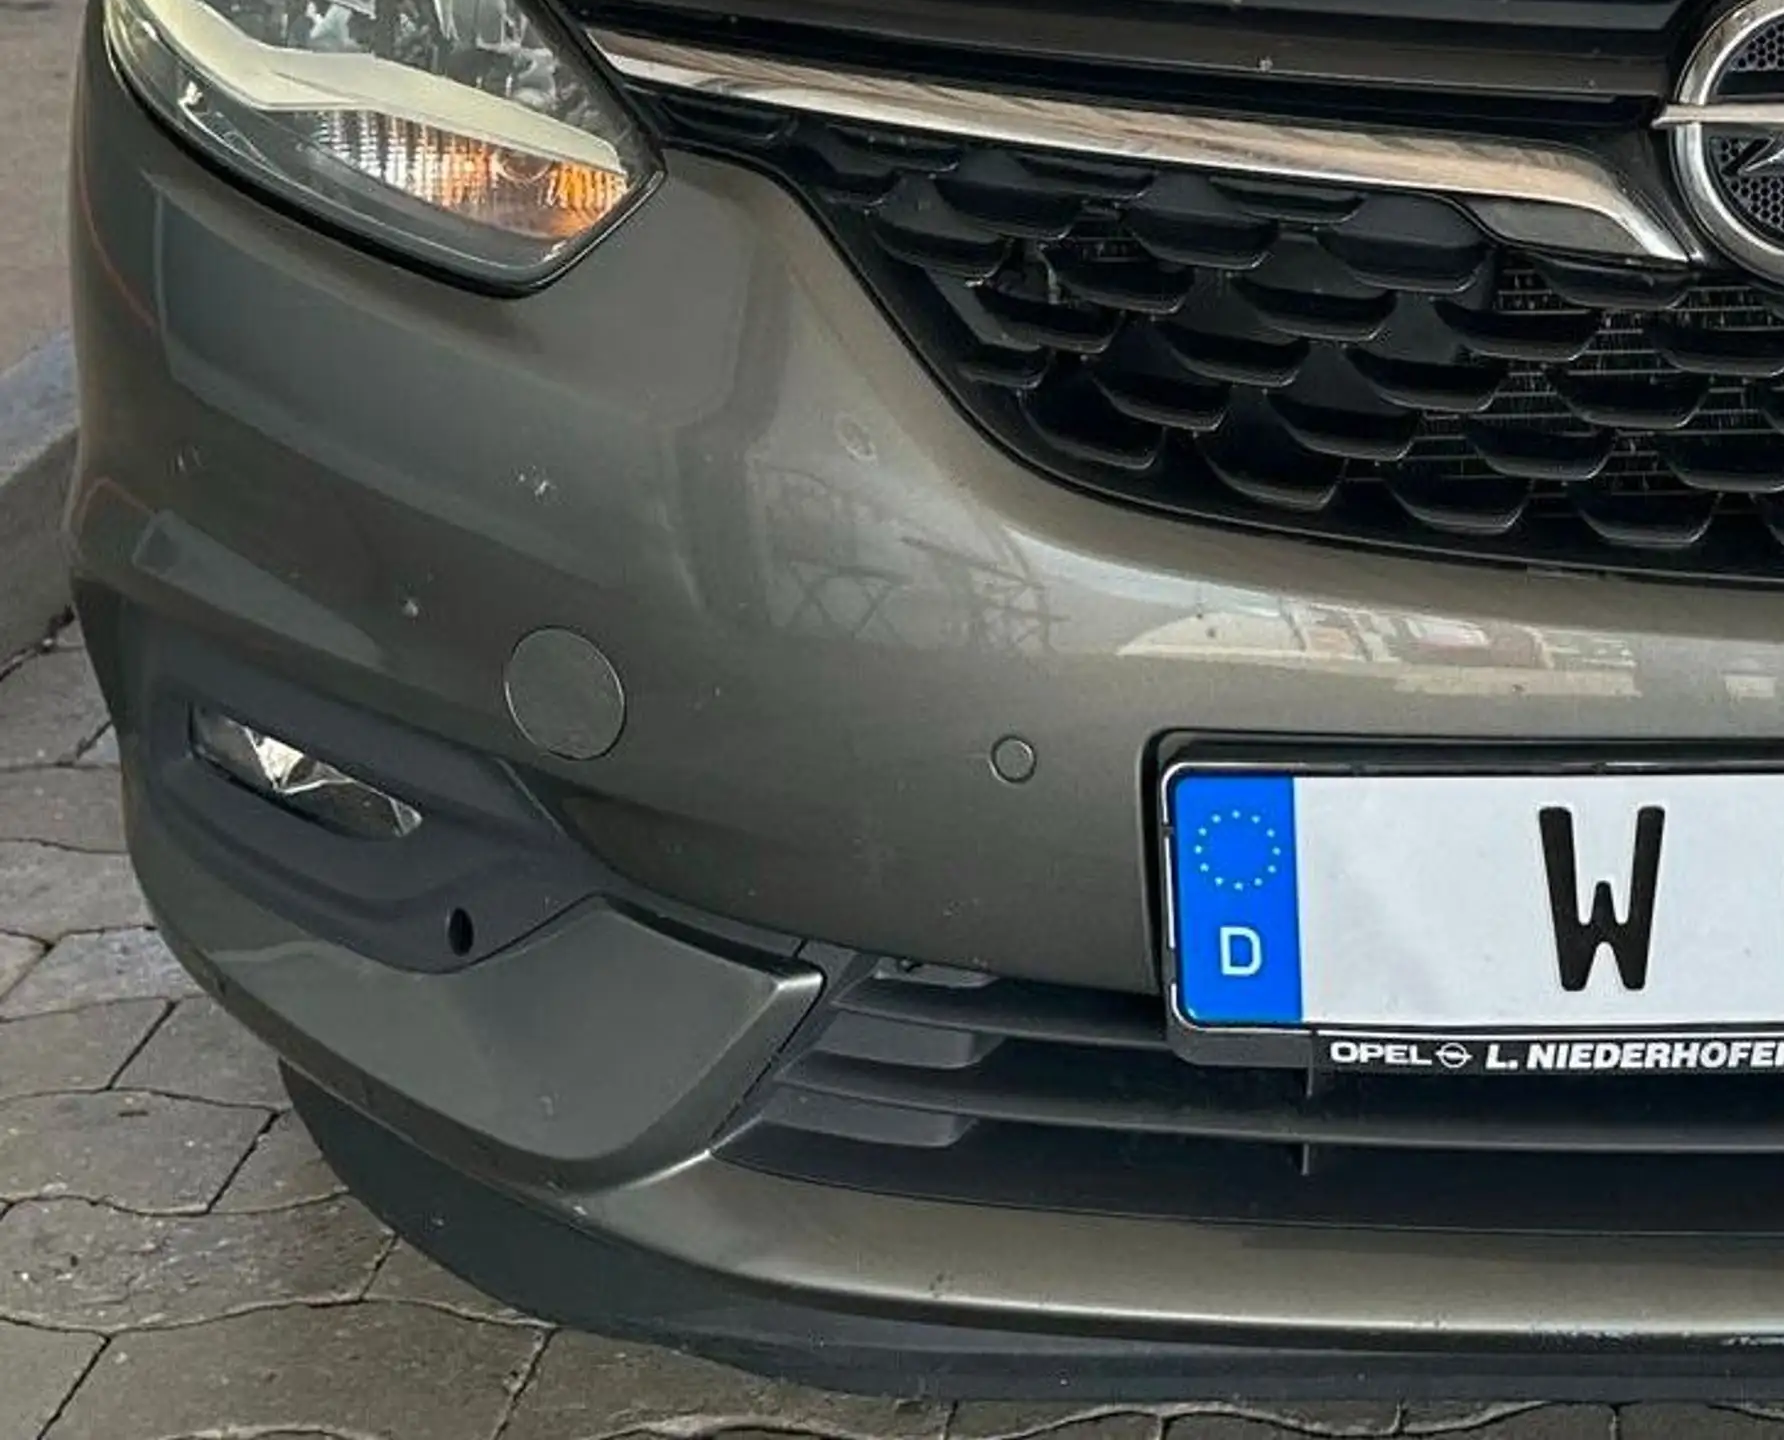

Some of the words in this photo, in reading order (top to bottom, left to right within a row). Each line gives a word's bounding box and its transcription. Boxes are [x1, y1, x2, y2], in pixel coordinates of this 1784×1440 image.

[1538, 806, 1666, 992] W
[1220, 926, 1262, 976] D
[1330, 1041, 1433, 1066] OPEL
[1485, 1043, 1519, 1070] L.
